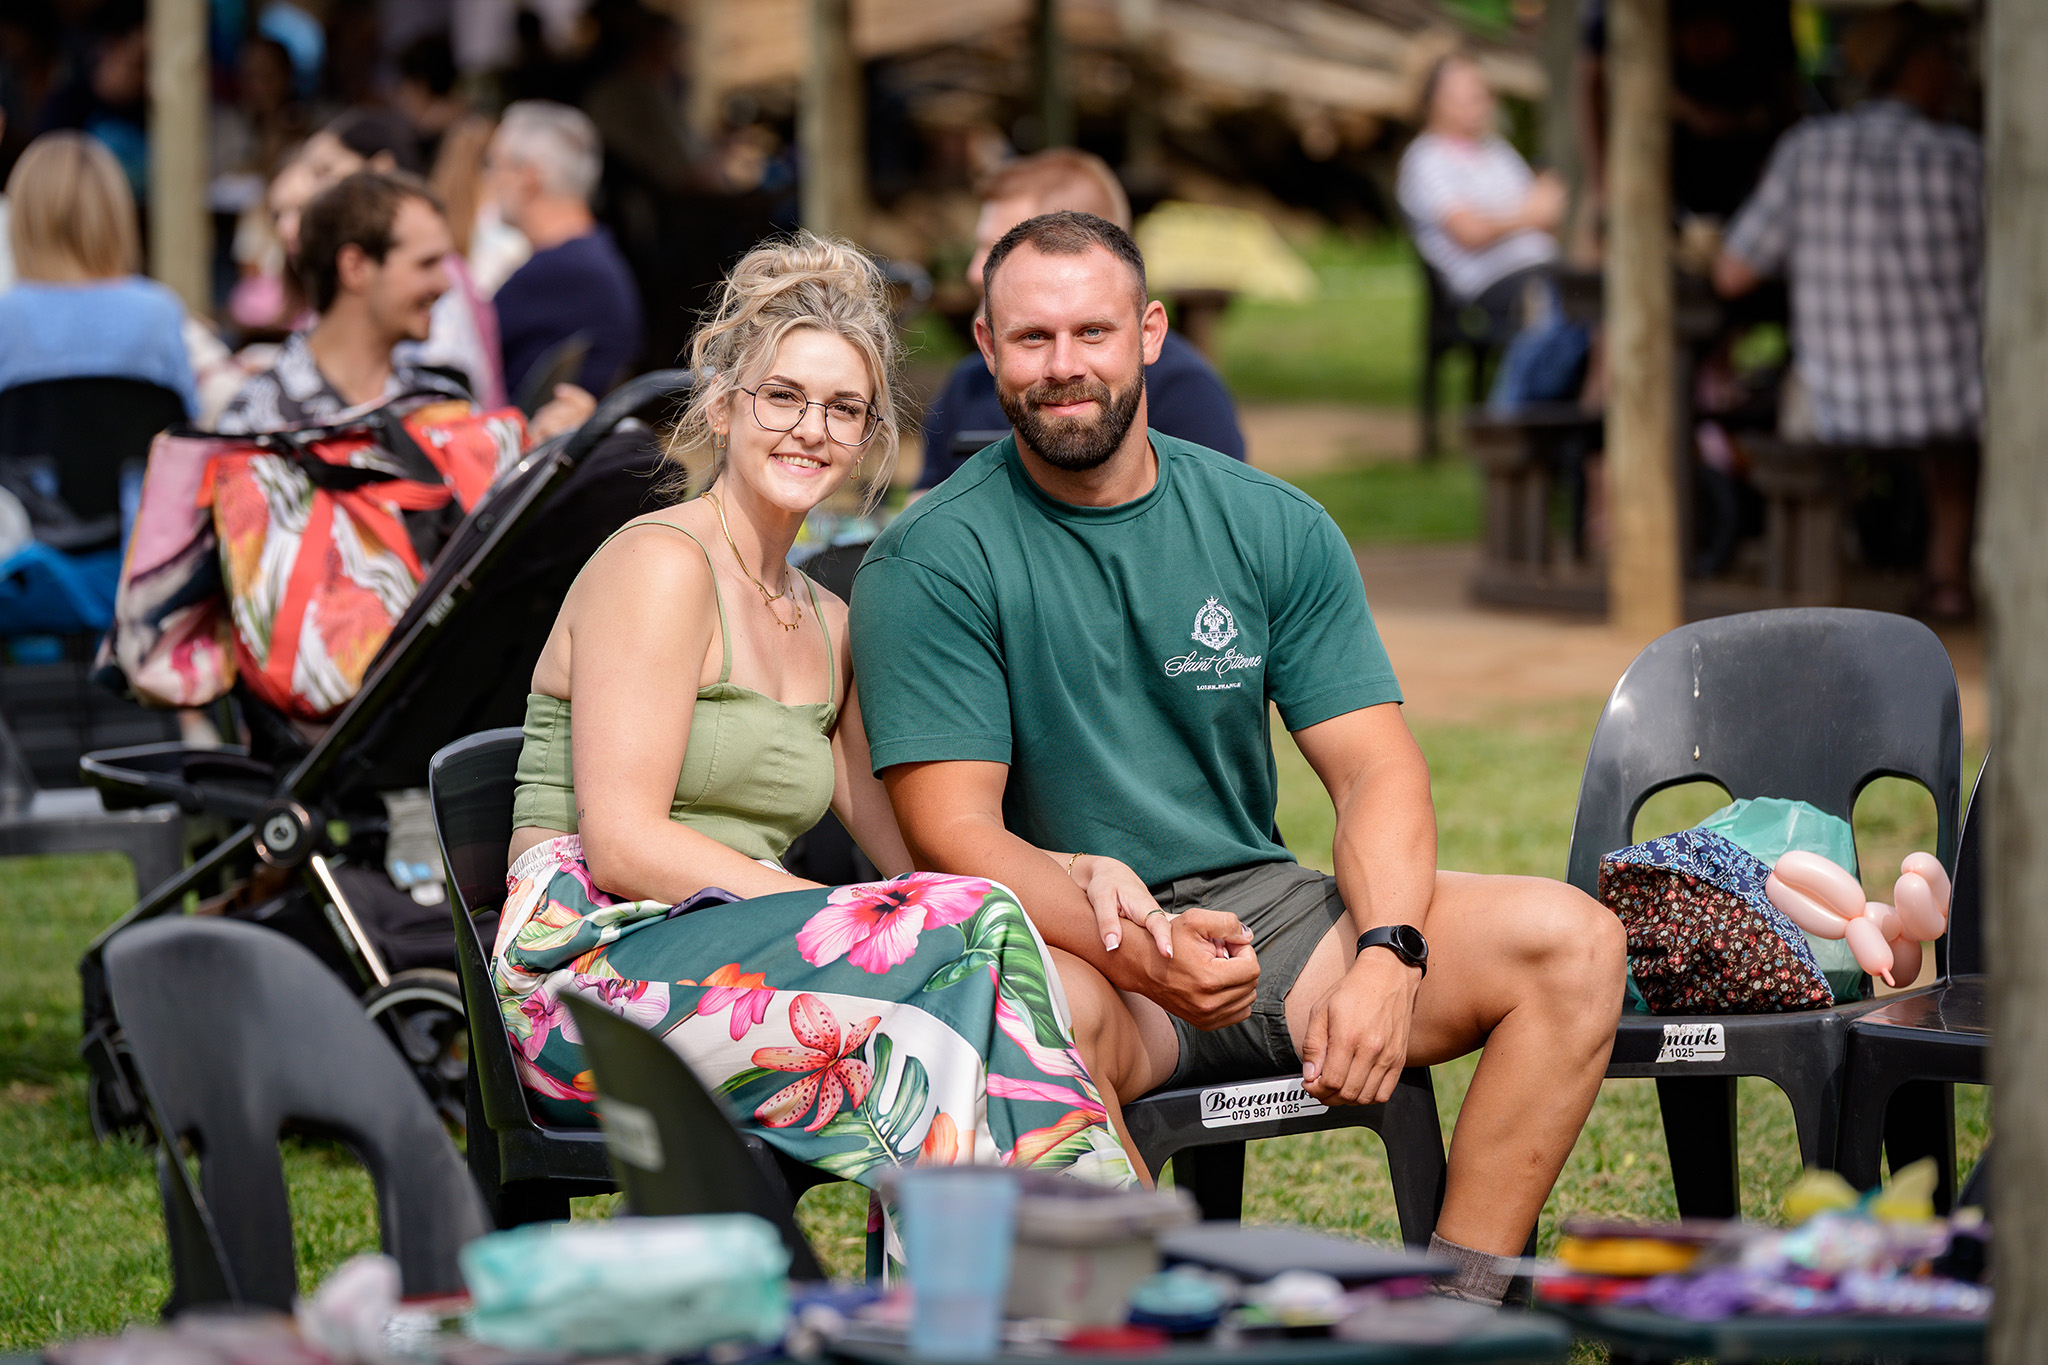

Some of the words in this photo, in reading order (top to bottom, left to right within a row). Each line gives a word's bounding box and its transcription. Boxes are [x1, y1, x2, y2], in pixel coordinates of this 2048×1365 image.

[1164, 650, 1219, 677] Saint
[1669, 1048, 1695, 1058] 1025
[1205, 1088, 1313, 1112] Boeremar
[1231, 1110, 1251, 1121] 079
[1253, 1107, 1272, 1118] 987
[1275, 1103, 1300, 1115] 1025
